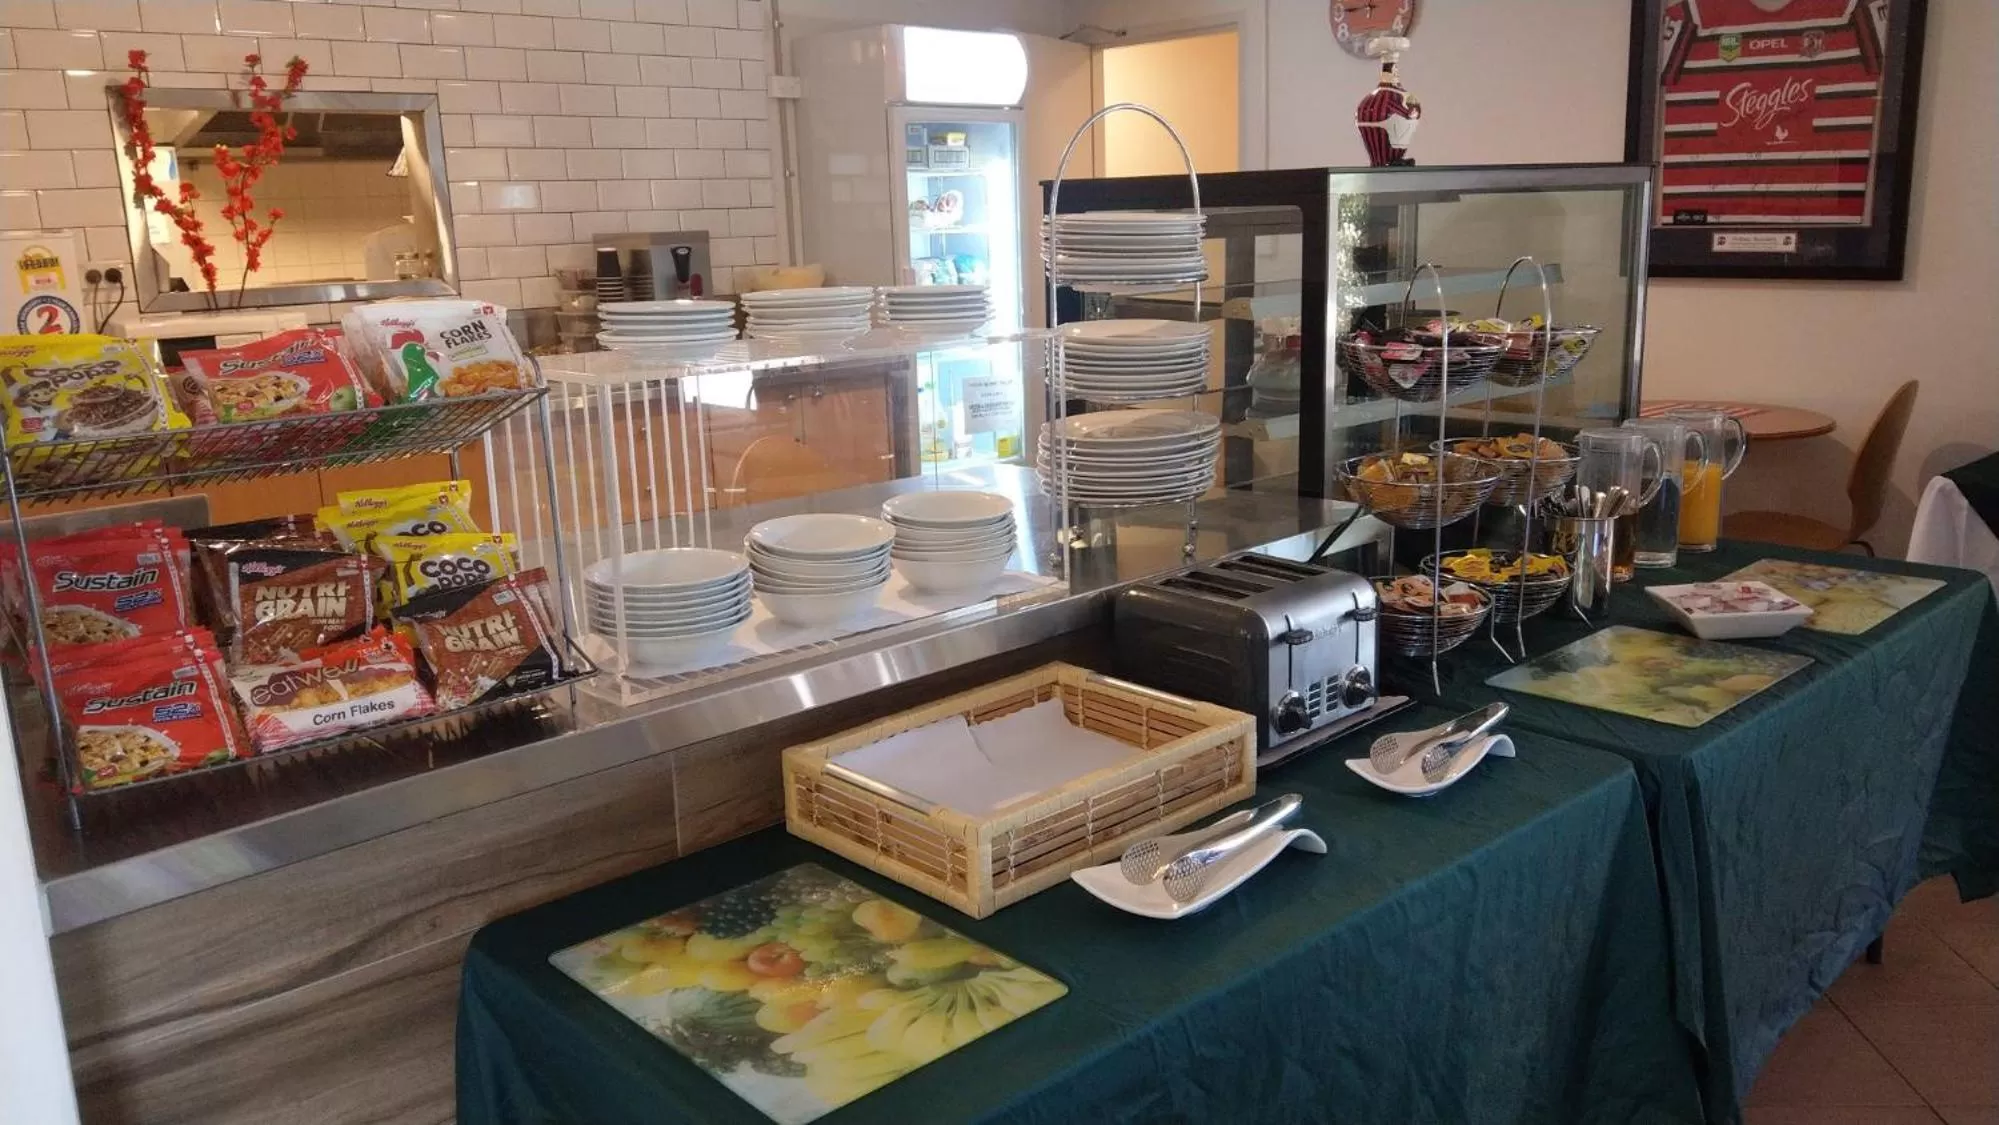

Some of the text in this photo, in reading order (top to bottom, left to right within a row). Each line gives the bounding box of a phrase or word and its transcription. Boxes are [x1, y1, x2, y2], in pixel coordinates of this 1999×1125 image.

[1749, 37, 1789, 50] OPEL
[1720, 76, 1813, 130] Steggles
[36, 305, 64, 334] 2
[439, 319, 487, 340] CORN
[444, 330, 493, 350] FLAKES
[52, 567, 160, 592] Sustain
[255, 581, 347, 602] NUTRI
[254, 596, 348, 624] GRAIN
[250, 657, 360, 706] eatwell
[83, 679, 197, 715] Sustain
[312, 711, 347, 727] Corn
[350, 699, 395, 717] Flakes
